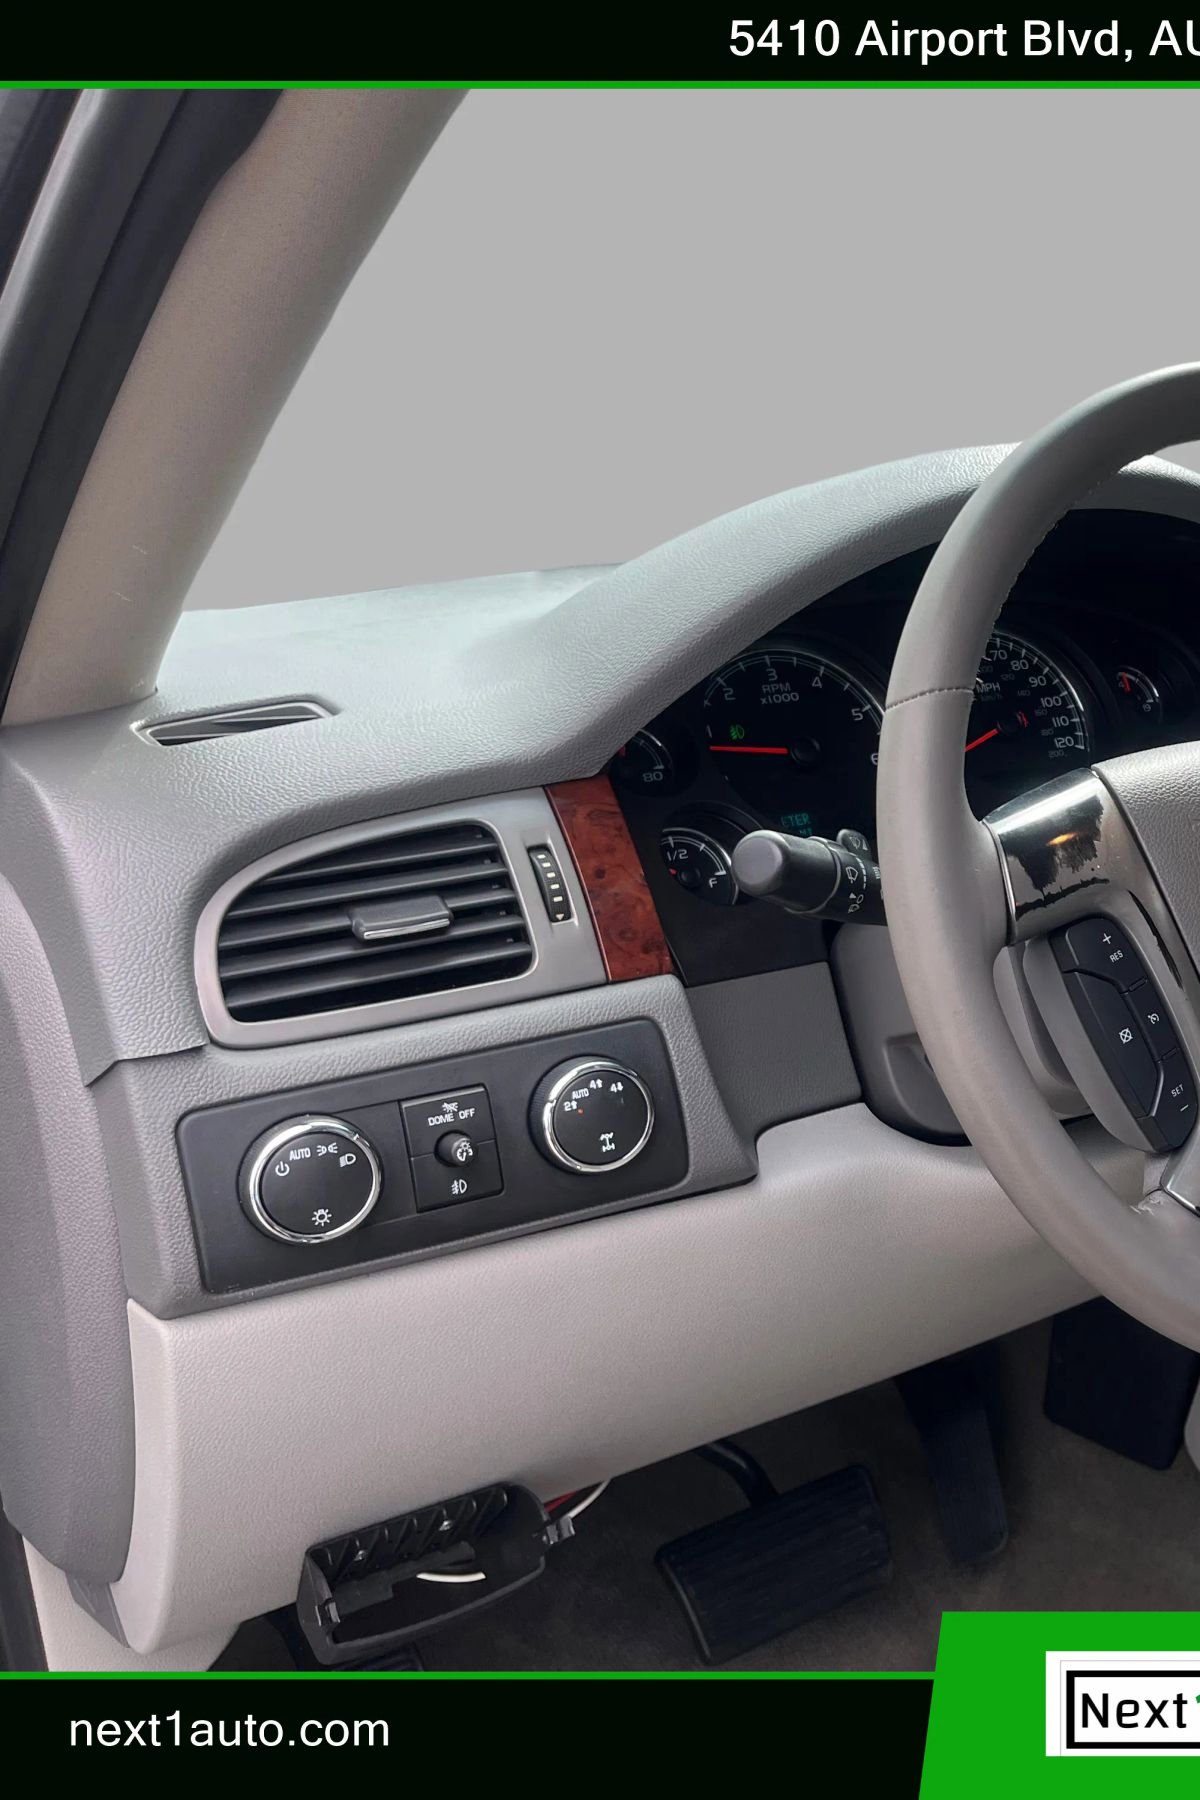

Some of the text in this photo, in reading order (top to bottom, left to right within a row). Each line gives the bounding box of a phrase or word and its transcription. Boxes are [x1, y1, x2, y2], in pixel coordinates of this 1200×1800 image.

[990, 650, 1007, 660] 70
[1010, 659, 1029, 671] 80
[765, 667, 778, 681] 3
[762, 682, 791, 694] RPM
[811, 676, 823, 689] 4
[976, 682, 1000, 694] MPH
[1028, 675, 1047, 688] 90
[723, 687, 736, 701] 2
[1040, 696, 1062, 708] 100
[850, 708, 864, 721] 5
[1052, 715, 1070, 728] 110
[1054, 736, 1075, 749] 120
[642, 771, 664, 783] 80
[667, 849, 688, 862] 1/2
[708, 877, 718, 889] F
[1109, 949, 1124, 963] RES
[572, 1087, 590, 1100] AUTO
[1171, 1084, 1185, 1098] SET
[427, 1107, 476, 1127] DOME OFF
[288, 1146, 312, 1162] AUTO
